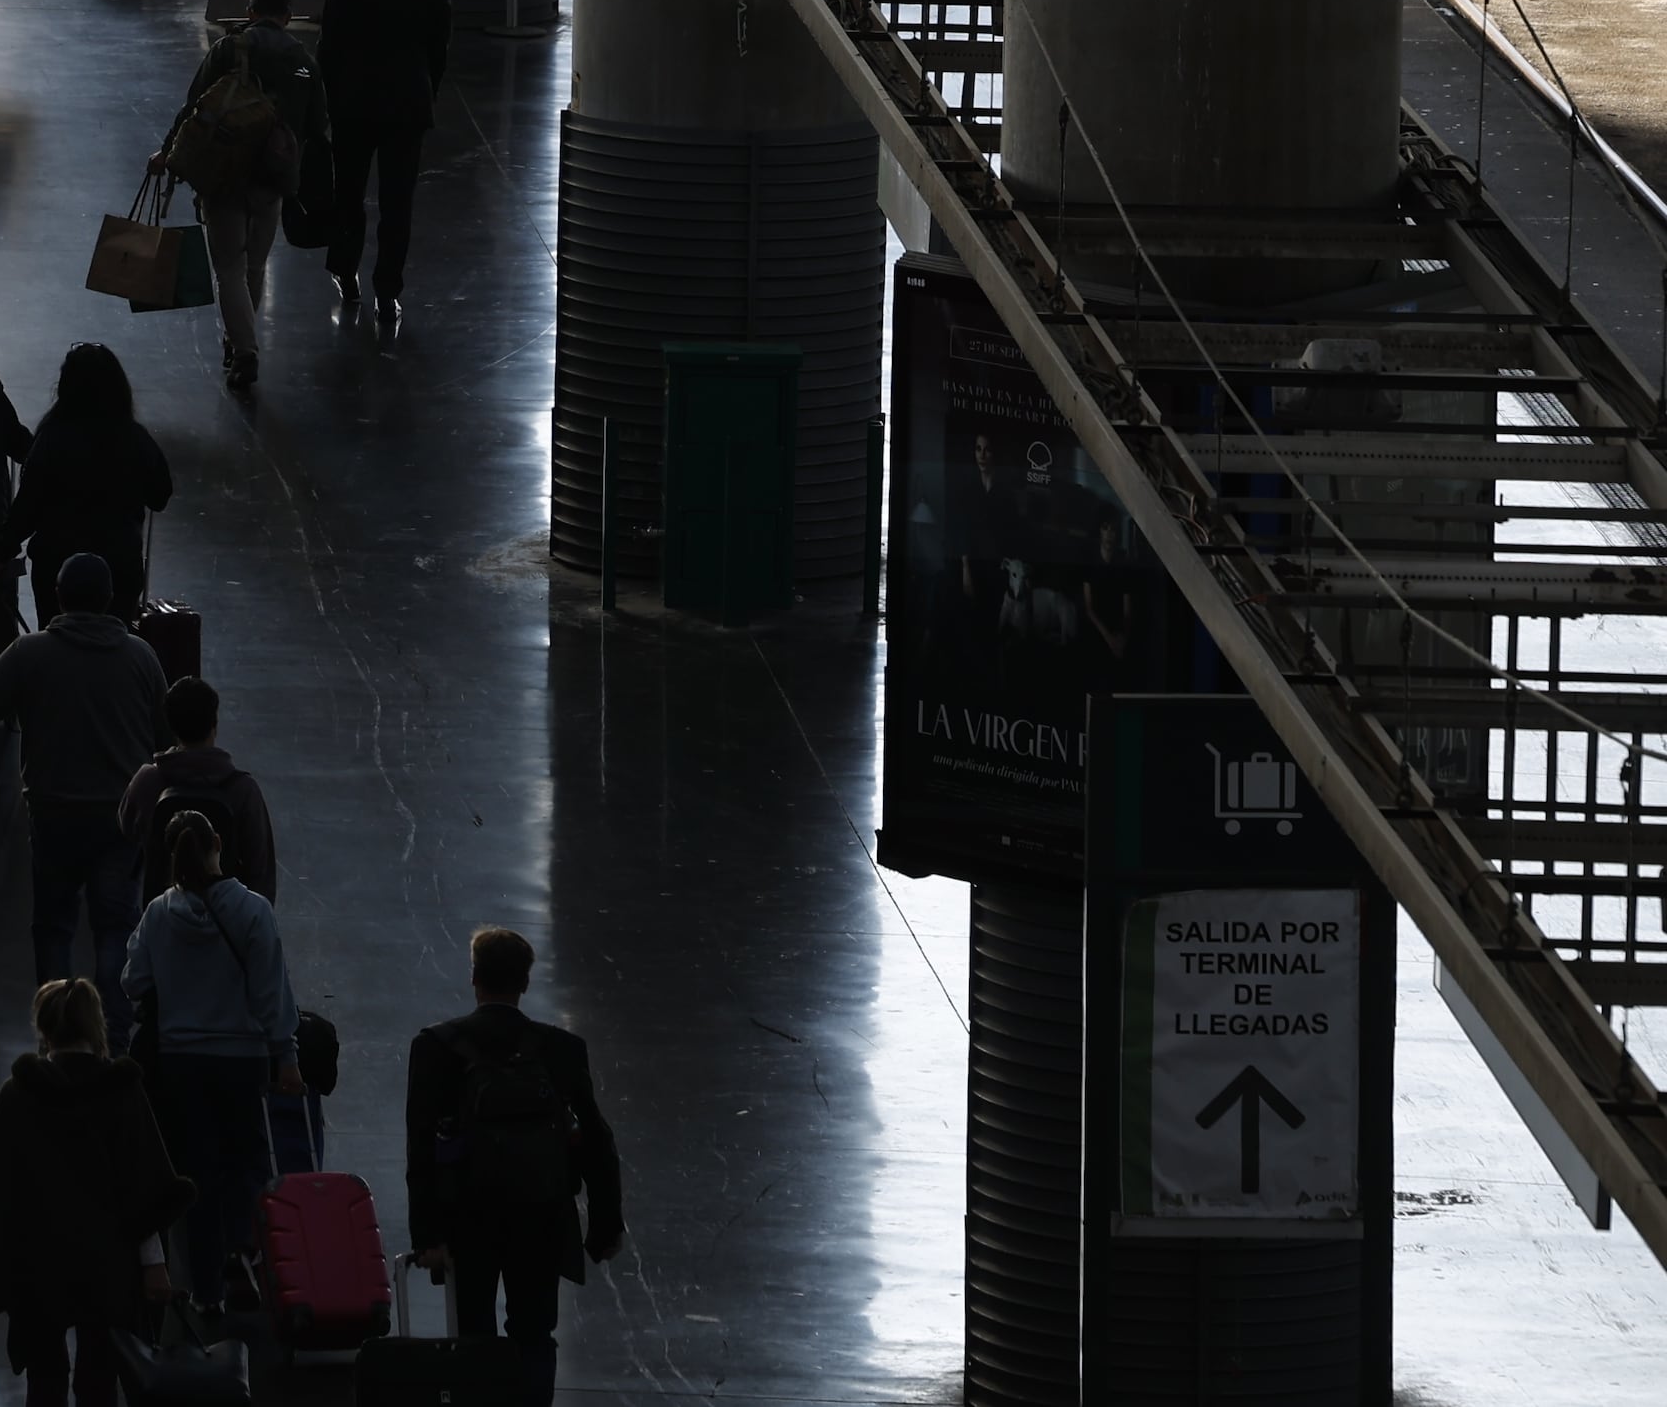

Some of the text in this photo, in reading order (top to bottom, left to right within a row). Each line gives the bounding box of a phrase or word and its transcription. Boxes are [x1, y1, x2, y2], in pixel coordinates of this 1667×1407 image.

[942, 378, 994, 399] BASADA
[997, 389, 1012, 402] EN
[1018, 393, 1034, 406] LA
[953, 397, 969, 409] DE
[974, 401, 1048, 424] HILDEGART
[1027, 471, 1051, 485] SSIFF
[917, 699, 953, 741] LA
[964, 708, 1068, 765] VIRGEN
[932, 753, 953, 767] una
[997, 765, 1040, 784] dirigida
[1040, 777, 1061, 790] por
[1167, 921, 1340, 943] SALIDA POR
[1180, 953, 1325, 975] TERMINAL
[1234, 984, 1272, 1006] DE
[1175, 1014, 1329, 1036] LLEGADAS
